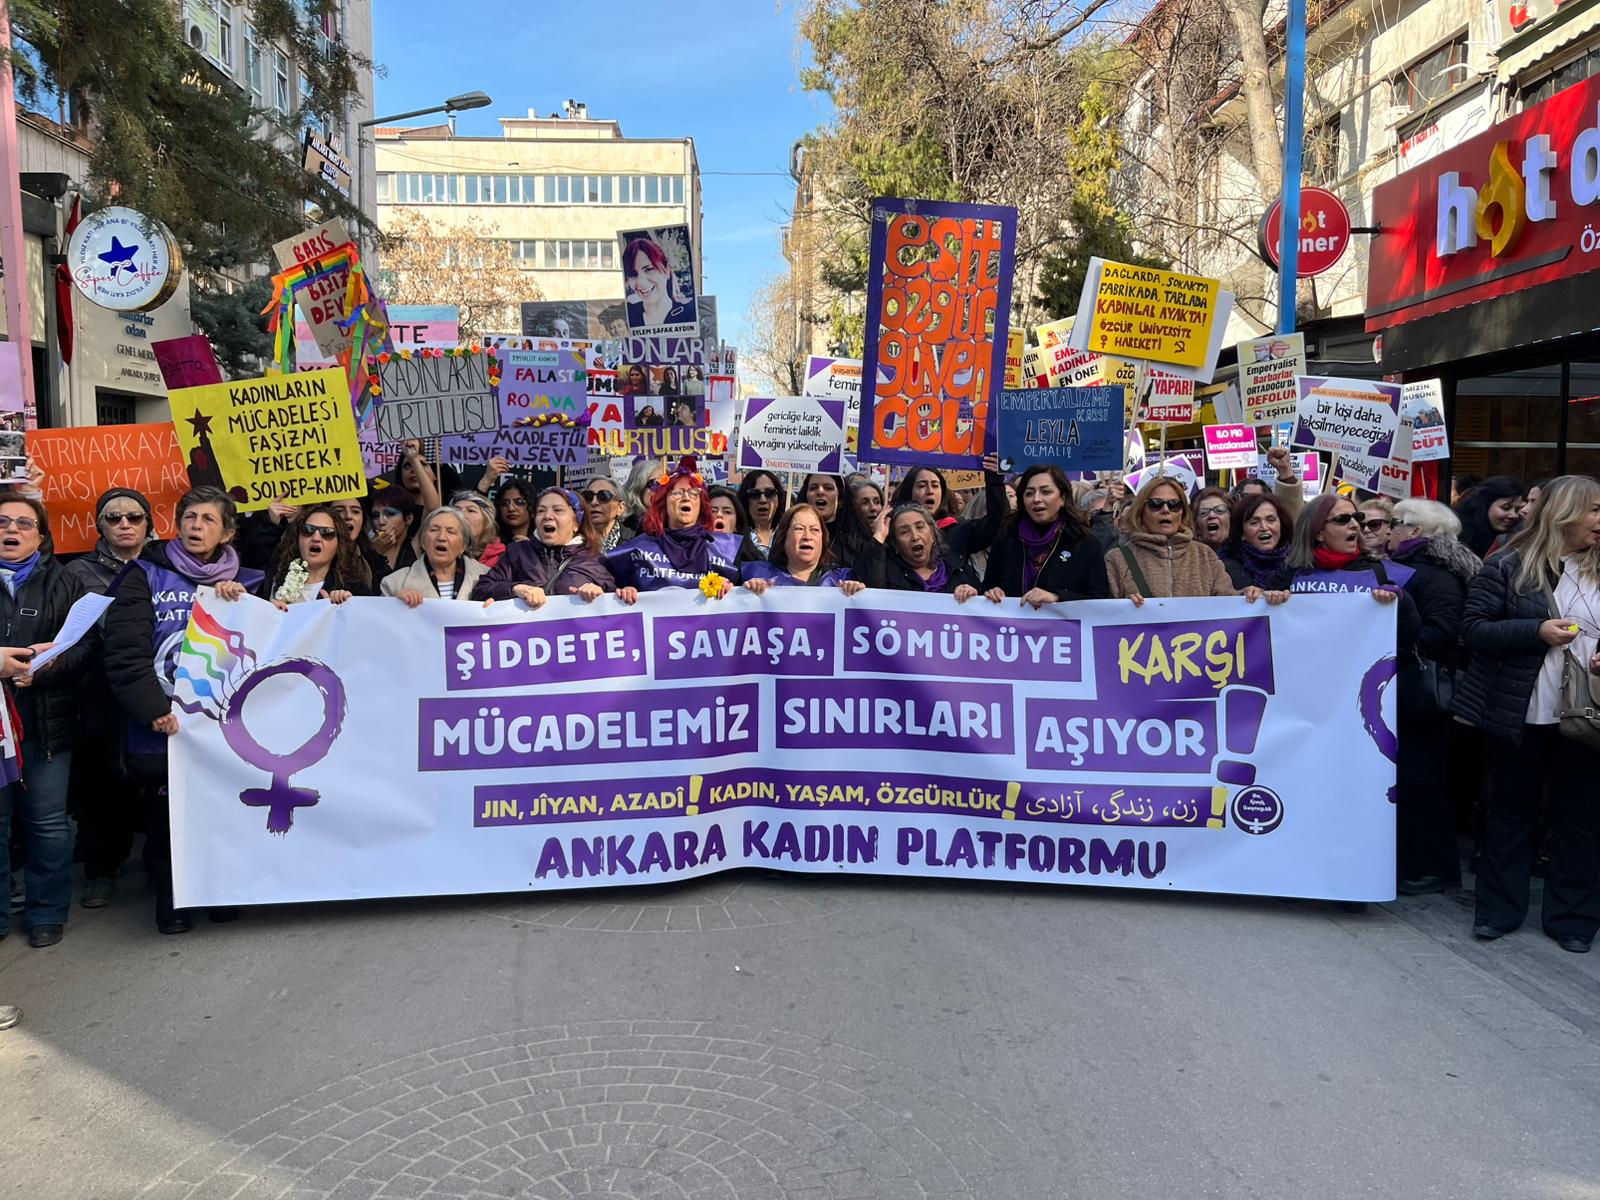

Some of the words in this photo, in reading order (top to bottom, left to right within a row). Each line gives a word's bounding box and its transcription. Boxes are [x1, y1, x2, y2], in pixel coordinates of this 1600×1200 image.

[1276, 236, 1340, 254] ner
[1246, 358, 1297, 376] Emperyalist
[1253, 370, 1294, 385] Barbarlar
[230, 378, 326, 407] KADINLARIN
[507, 392, 576, 410] ROJAVA
[1154, 379, 1192, 396] YAPAR!
[228, 397, 339, 433] MÜCADELESİ
[376, 394, 497, 442] KURTULUŞU
[1152, 406, 1191, 419] EŞİTLİK
[1317, 400, 1332, 414] bir
[1335, 402, 1352, 421] kişi
[1354, 407, 1382, 423] daha
[250, 424, 327, 452] FAŞİZMİ
[764, 423, 798, 435] feminist
[1024, 418, 1080, 446] LEYLA
[249, 448, 341, 474] YENECEK!
[1024, 445, 1071, 458] OLMALI!
[250, 472, 360, 501] SOLDEP-KADIN
[456, 629, 640, 680] ŞİDDETE,
[668, 626, 826, 665] SAVAŞA,
[852, 619, 1072, 666] SÖMÜRÜYE
[1118, 630, 1246, 689] KARŞI
[433, 696, 750, 756] MÜCADELEMİZ
[783, 697, 1002, 740] SINIRLARI
[481, 800, 525, 820] JIN,
[709, 782, 780, 804] KADIN,
[785, 784, 870, 806] YAŞAM,
[1025, 790, 1084, 819] آزادی
[534, 823, 727, 879] ANKARA
[743, 820, 880, 865] KADIN
[896, 826, 1168, 880] PLATFORMU
